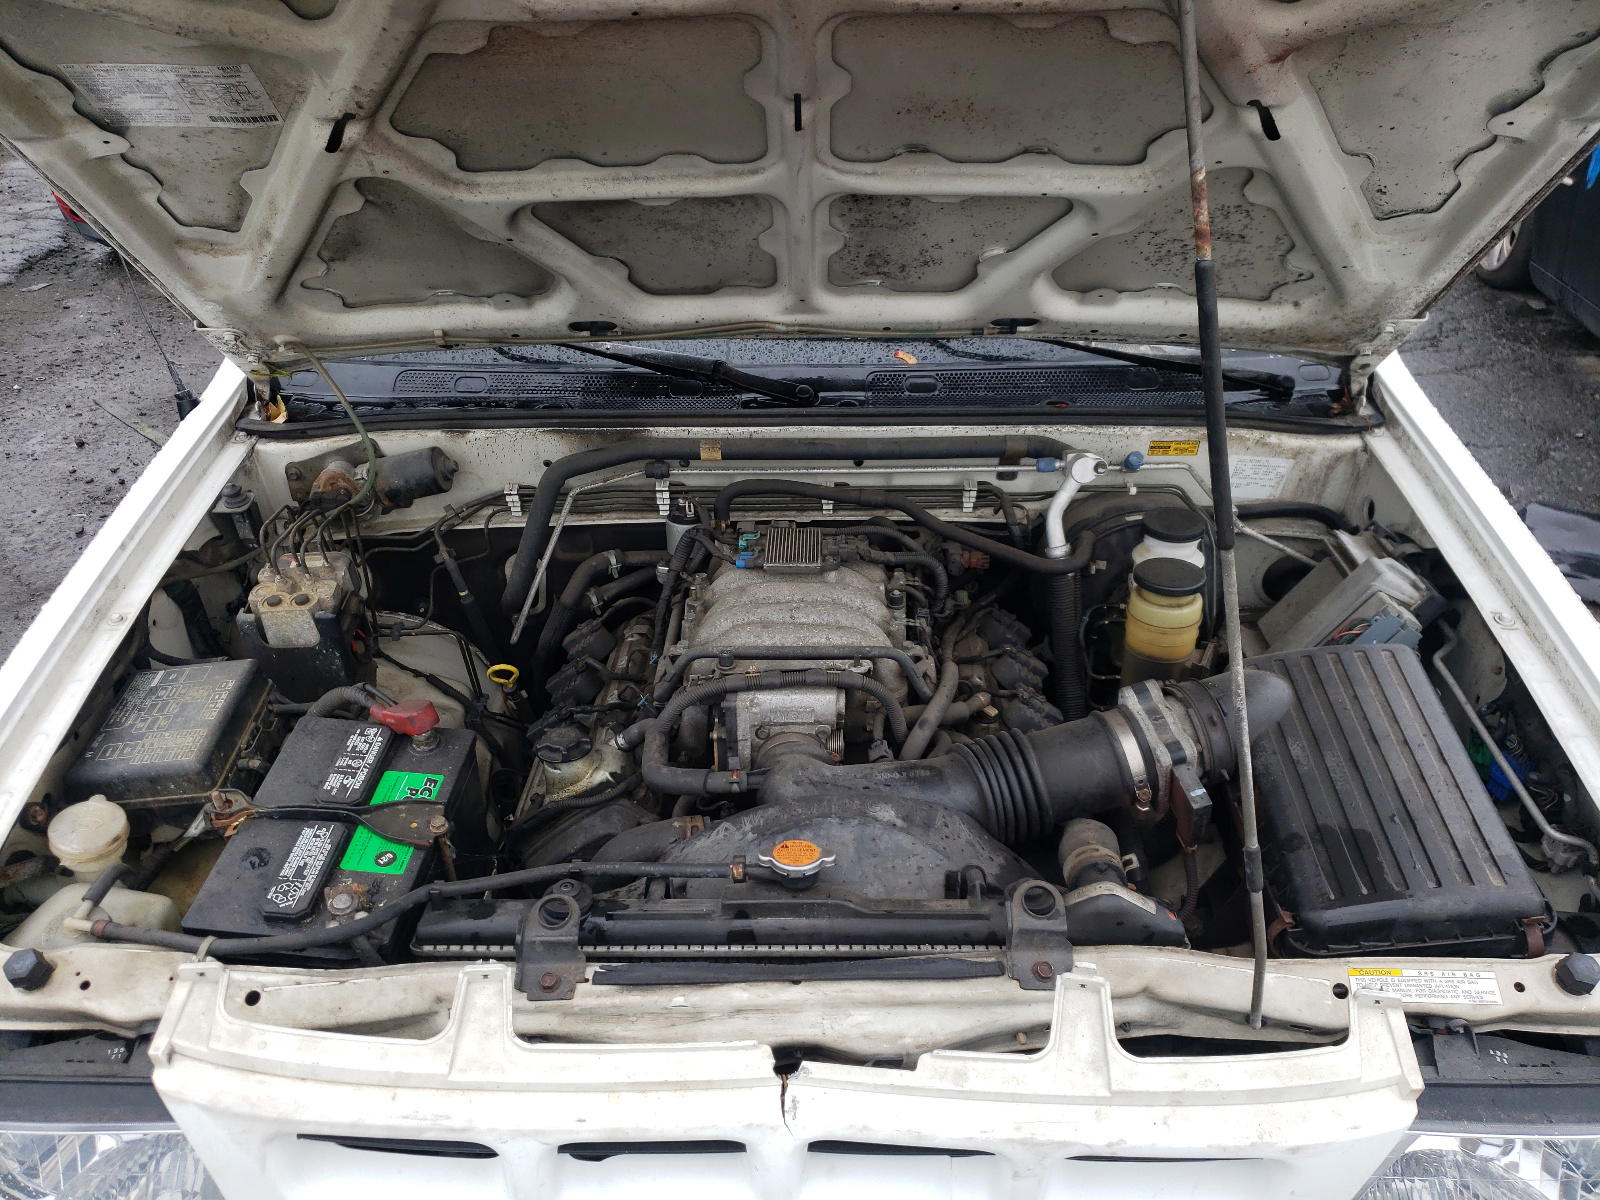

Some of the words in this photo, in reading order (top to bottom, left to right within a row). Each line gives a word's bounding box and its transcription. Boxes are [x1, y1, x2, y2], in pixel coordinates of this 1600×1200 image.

[366, 741, 381, 764] DANGER
[353, 767, 369, 789] POISON
[413, 776, 440, 800] EC
